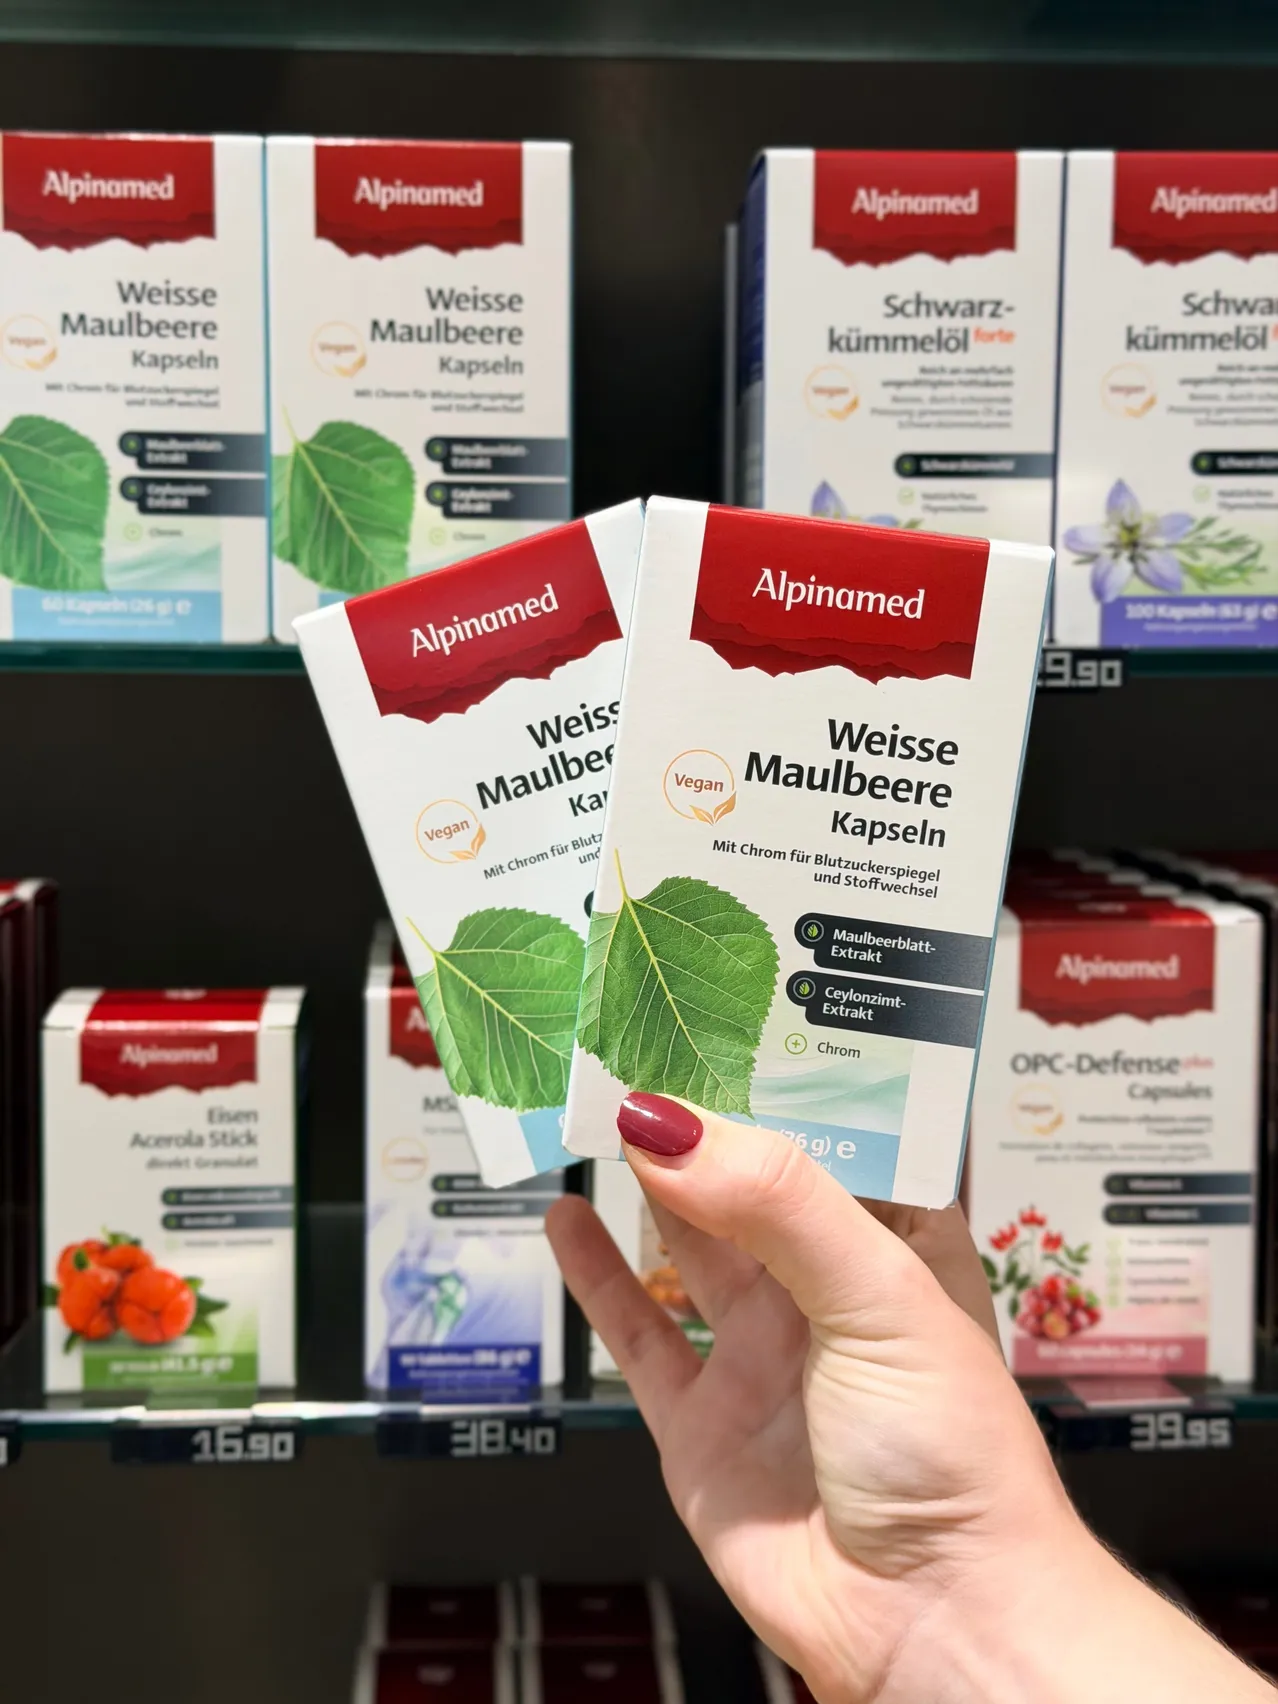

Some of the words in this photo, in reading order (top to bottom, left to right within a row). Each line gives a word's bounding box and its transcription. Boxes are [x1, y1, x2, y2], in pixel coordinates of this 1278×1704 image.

[43, 170, 175, 203] Alpinamed
[355, 178, 483, 210] Alpinamed
[852, 189, 978, 221] Alpinamed
[1150, 186, 1277, 220] Alpinamed
[117, 280, 217, 307] Weisse
[425, 287, 524, 313] Weisse
[884, 291, 1015, 319] Schwarz-
[1182, 290, 1278, 316] Schwa
[61, 312, 218, 340] Maulbeere
[370, 317, 524, 346] Maulbeere
[828, 326, 969, 354] kümmelöl
[973, 326, 1016, 344] forte
[1126, 324, 1267, 352] kümmelöl
[132, 350, 219, 374] Kapseln
[439, 356, 524, 379] Kapseln
[752, 567, 925, 621] Alpinamed
[410, 583, 559, 658] Alpinamed
[1037, 651, 1122, 687] 9.90
[525, 700, 620, 749] Weiss
[827, 718, 959, 766] Weisse
[673, 772, 725, 793] Vegan
[744, 751, 952, 809] Maulbeere
[568, 789, 608, 818] Ka
[424, 819, 470, 843] Vegan
[831, 809, 946, 849] Kapseln
[483, 864, 506, 879] Mit
[507, 851, 549, 871] Chrom
[550, 844, 569, 858] für
[571, 833, 602, 851] Blutz
[712, 839, 737, 855] Mit
[740, 842, 787, 862] Chrom
[789, 849, 812, 865] für
[813, 852, 941, 883] Blutzuckerspiegel
[813, 870, 841, 886] und
[844, 873, 938, 899] Stoffwechsel
[830, 944, 883, 965] Extrakt
[833, 928, 937, 956] Maulbeerblatt-
[1056, 953, 1180, 985] Alpinamed
[822, 1001, 874, 1022] Extrakt
[824, 986, 907, 1011] Ceylonzimt-
[120, 1042, 218, 1068] Alpinamed
[817, 1041, 861, 1059] Chrom
[1010, 1051, 1180, 1076] OPC-Defense
[1128, 1081, 1212, 1102] Capsules
[208, 1107, 258, 1125] Eisen
[130, 1130, 205, 1149] Acerola
[209, 1128, 258, 1148] Stick
[811, 1136, 831, 1157] g)
[192, 1425, 295, 1462] 16.90
[452, 1420, 555, 1457] 38.40
[1130, 1411, 1230, 1450] 39.95
